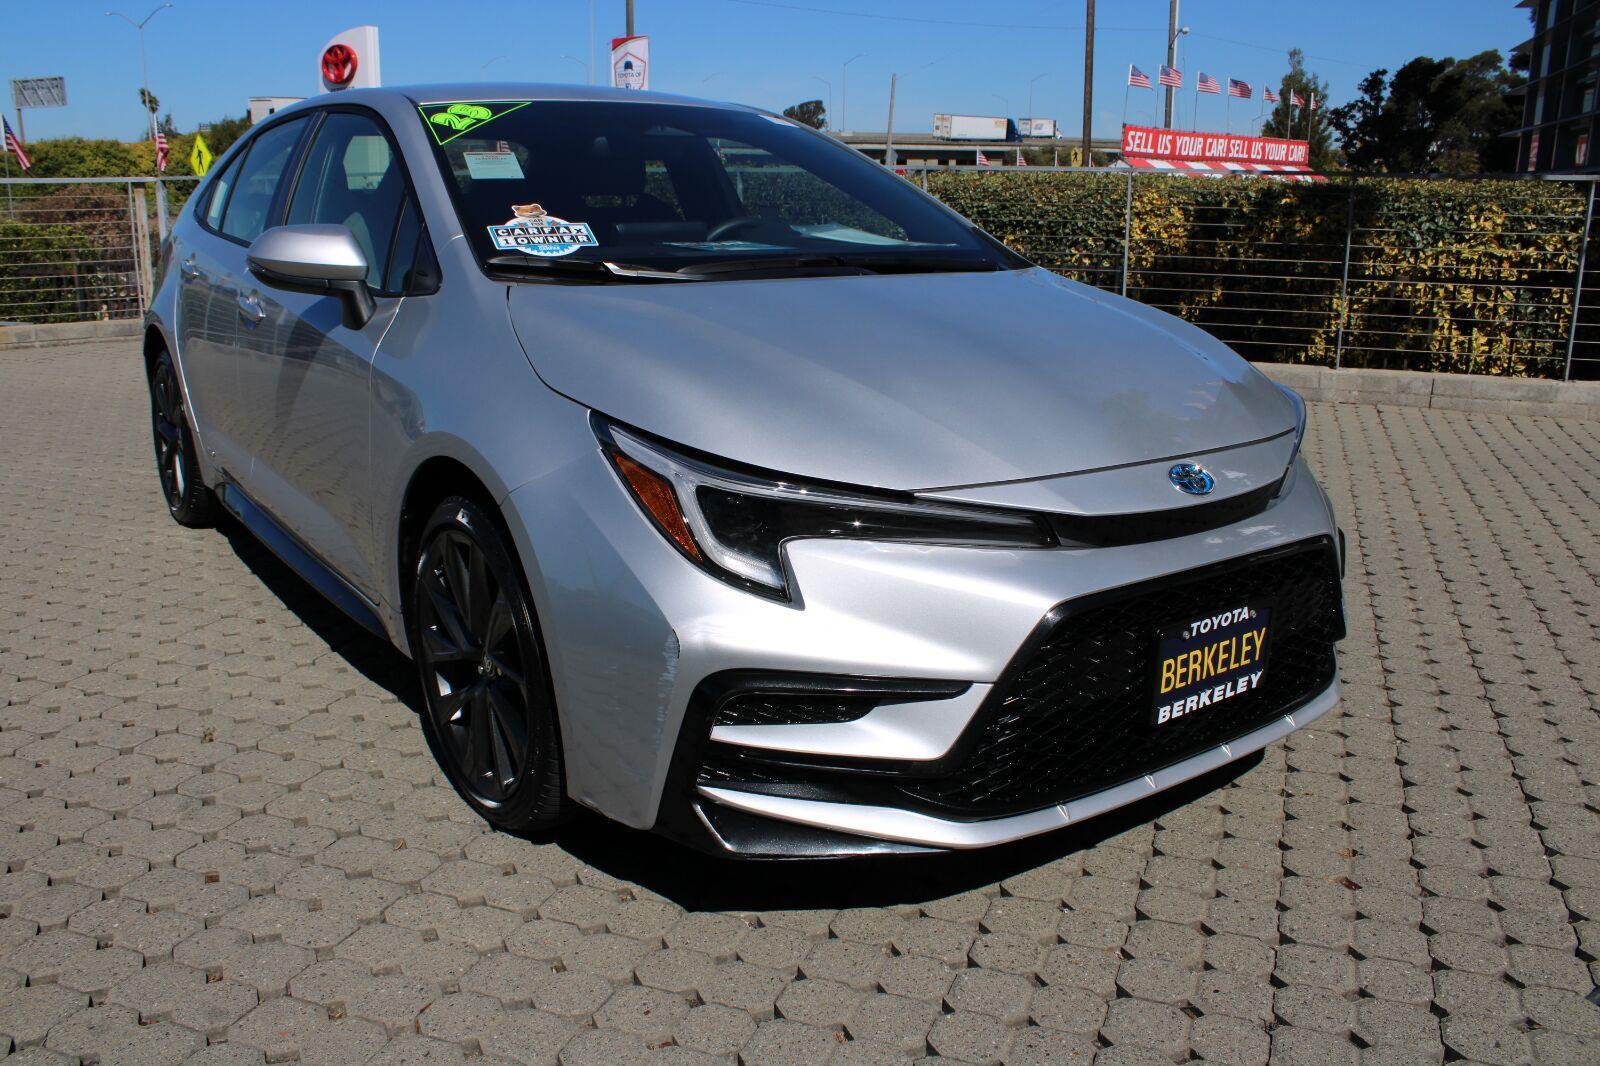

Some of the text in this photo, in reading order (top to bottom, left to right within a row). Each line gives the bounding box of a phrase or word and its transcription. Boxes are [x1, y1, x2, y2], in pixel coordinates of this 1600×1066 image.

[1125, 130, 1306, 162] SELL US YOUR CAR! SELL US YOUR CAR!
[497, 226, 585, 236] CARFAX
[517, 235, 589, 245] OWNER
[1190, 606, 1250, 637] TOYOTA
[1160, 627, 1266, 694] BERKELEY
[1157, 669, 1264, 725] BERKELEY
